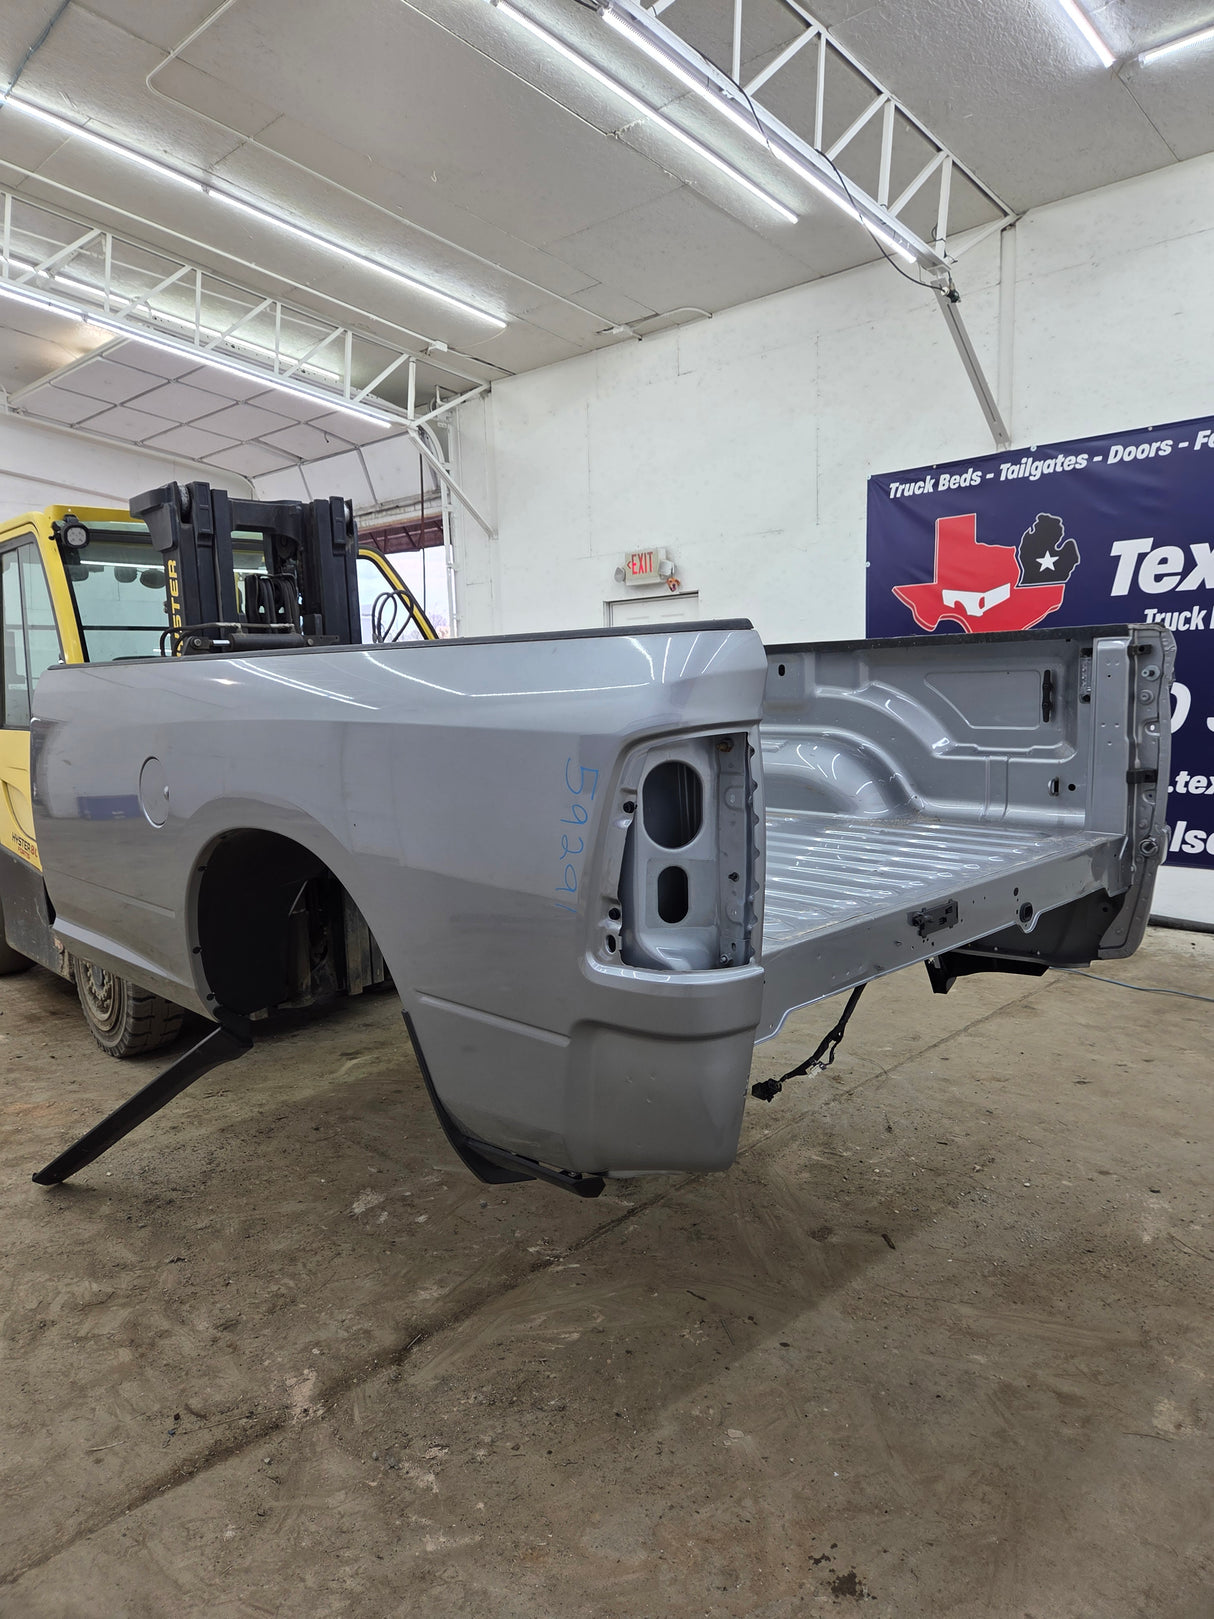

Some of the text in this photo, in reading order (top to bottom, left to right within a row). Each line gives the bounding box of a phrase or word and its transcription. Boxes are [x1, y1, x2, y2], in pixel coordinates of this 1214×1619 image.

[889, 476, 936, 499] Truck
[937, 468, 983, 492] Beds
[999, 453, 1089, 481] Tailgates
[1107, 439, 1173, 465] Doors
[631, 551, 653, 575] EXIT
[167, 559, 184, 657] YSTER
[1143, 605, 1208, 631] Truck
